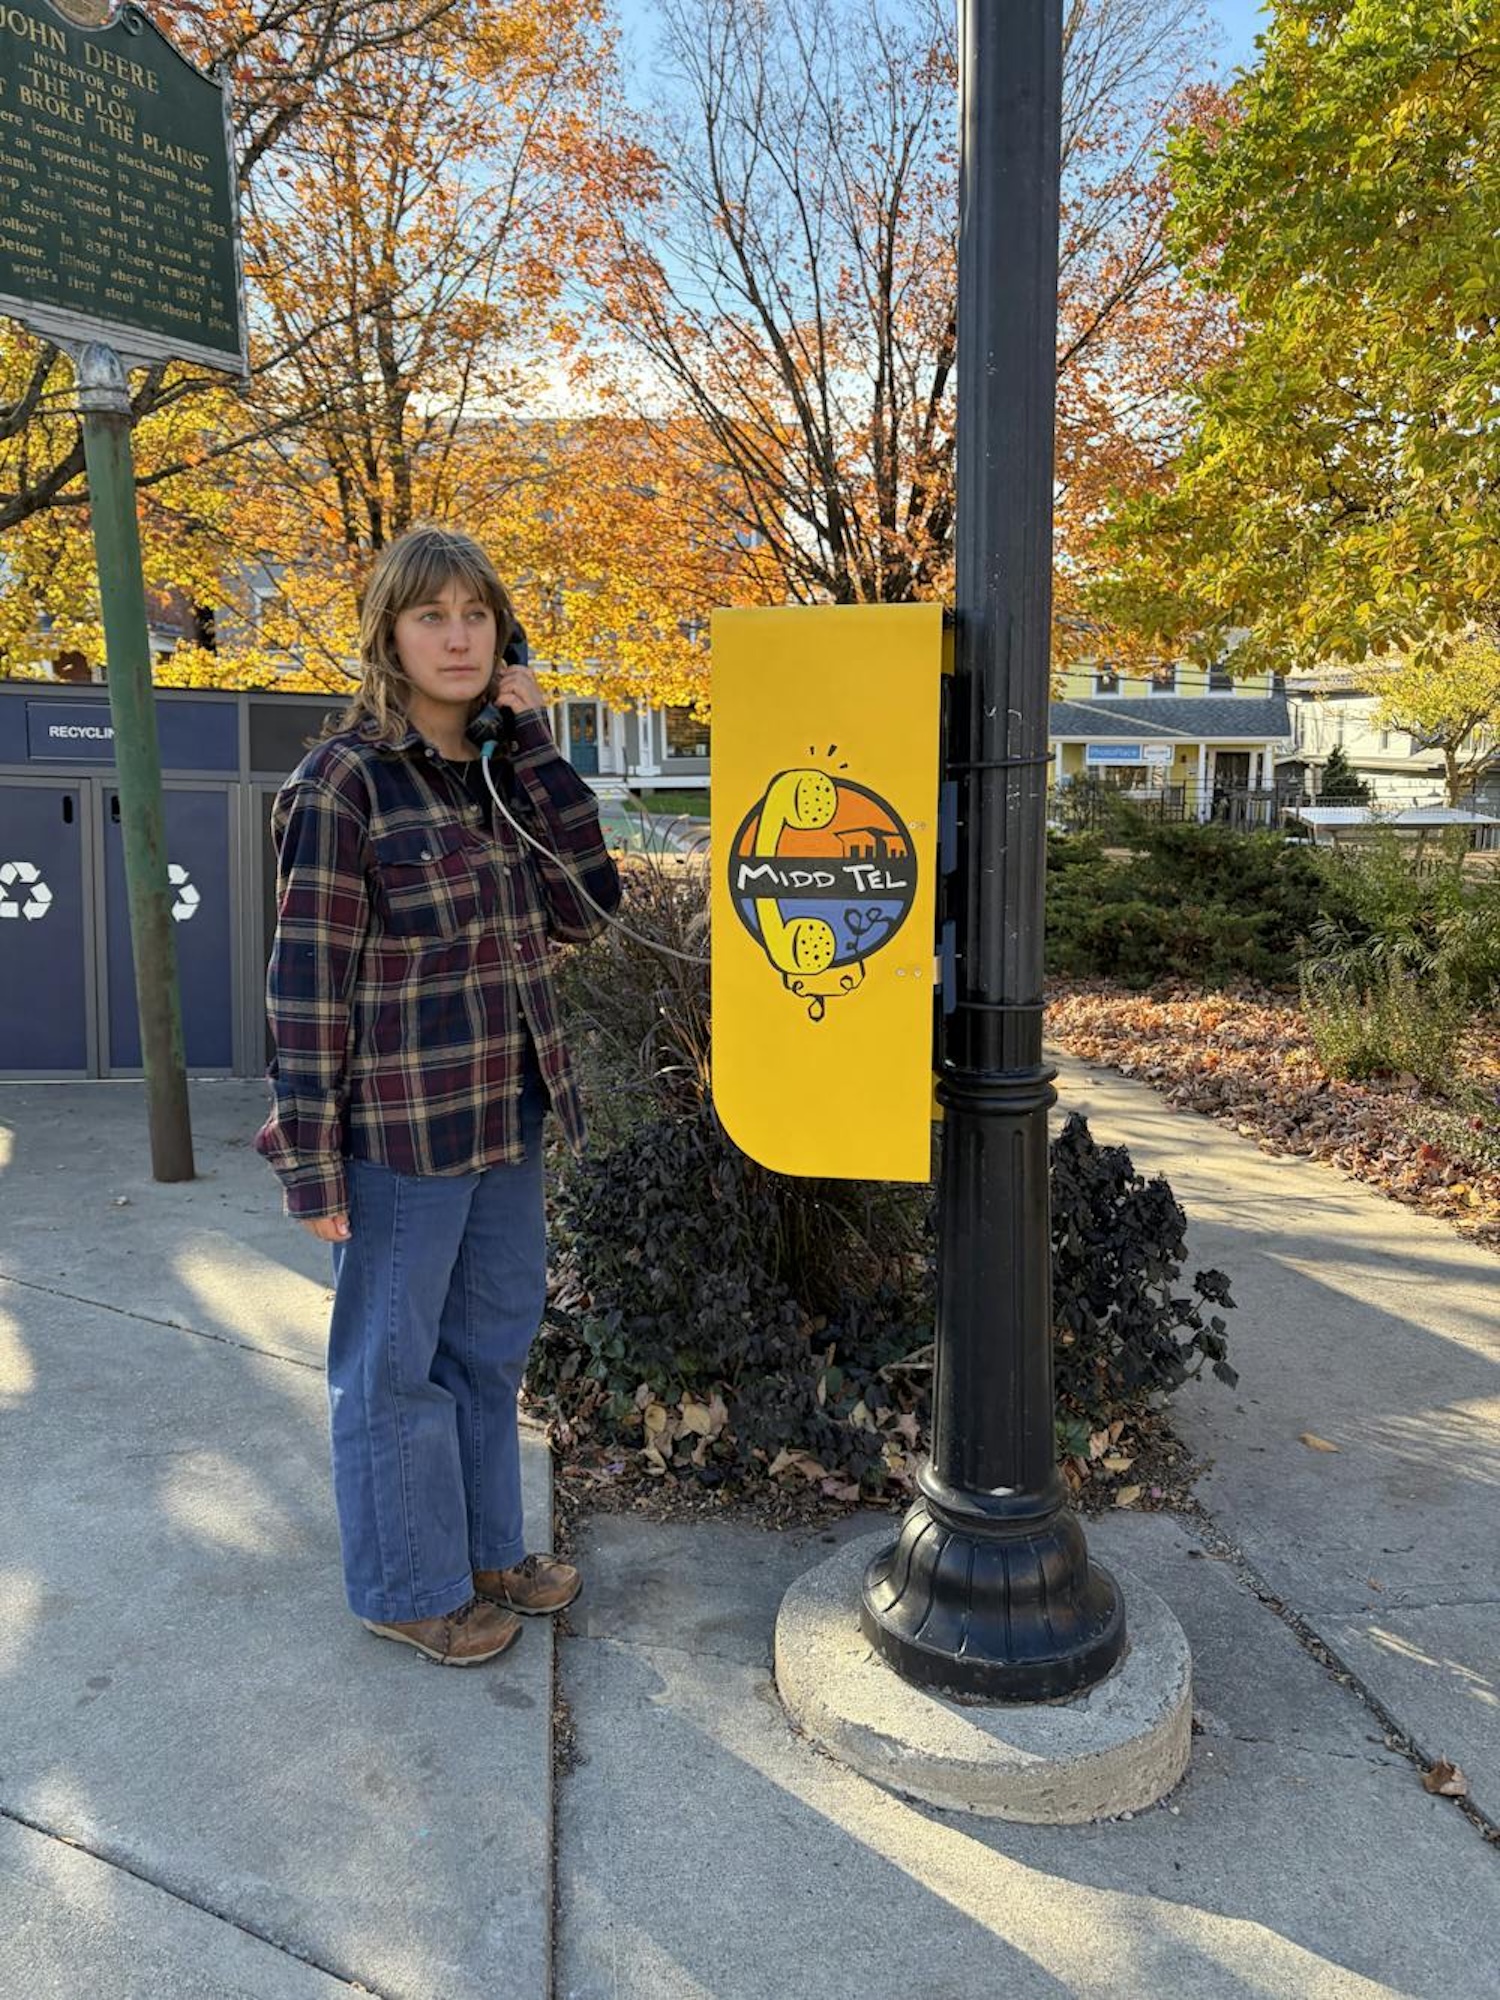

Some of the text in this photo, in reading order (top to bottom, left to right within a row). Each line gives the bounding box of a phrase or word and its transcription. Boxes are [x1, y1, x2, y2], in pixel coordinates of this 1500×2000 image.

[0, 4, 160, 94] JOHN DEERE
[33, 51, 107, 92] INVENTOR
[111, 84, 129, 100] OF
[19, 84, 85, 126] BROKE
[95, 115, 134, 145] THE
[84, 90, 137, 125] PLOW
[0, 110, 23, 127] ere
[31, 118, 81, 148] learned
[117, 152, 179, 183] blacksmith
[184, 177, 214, 197] trade
[14, 137, 31, 151] an
[40, 145, 110, 178] apprentice
[117, 248, 154, 271] Deere
[104, 287, 133, 304] steel
[48, 725, 115, 739] RECYCLIN
[737, 863, 907, 893] MIDD TEL
